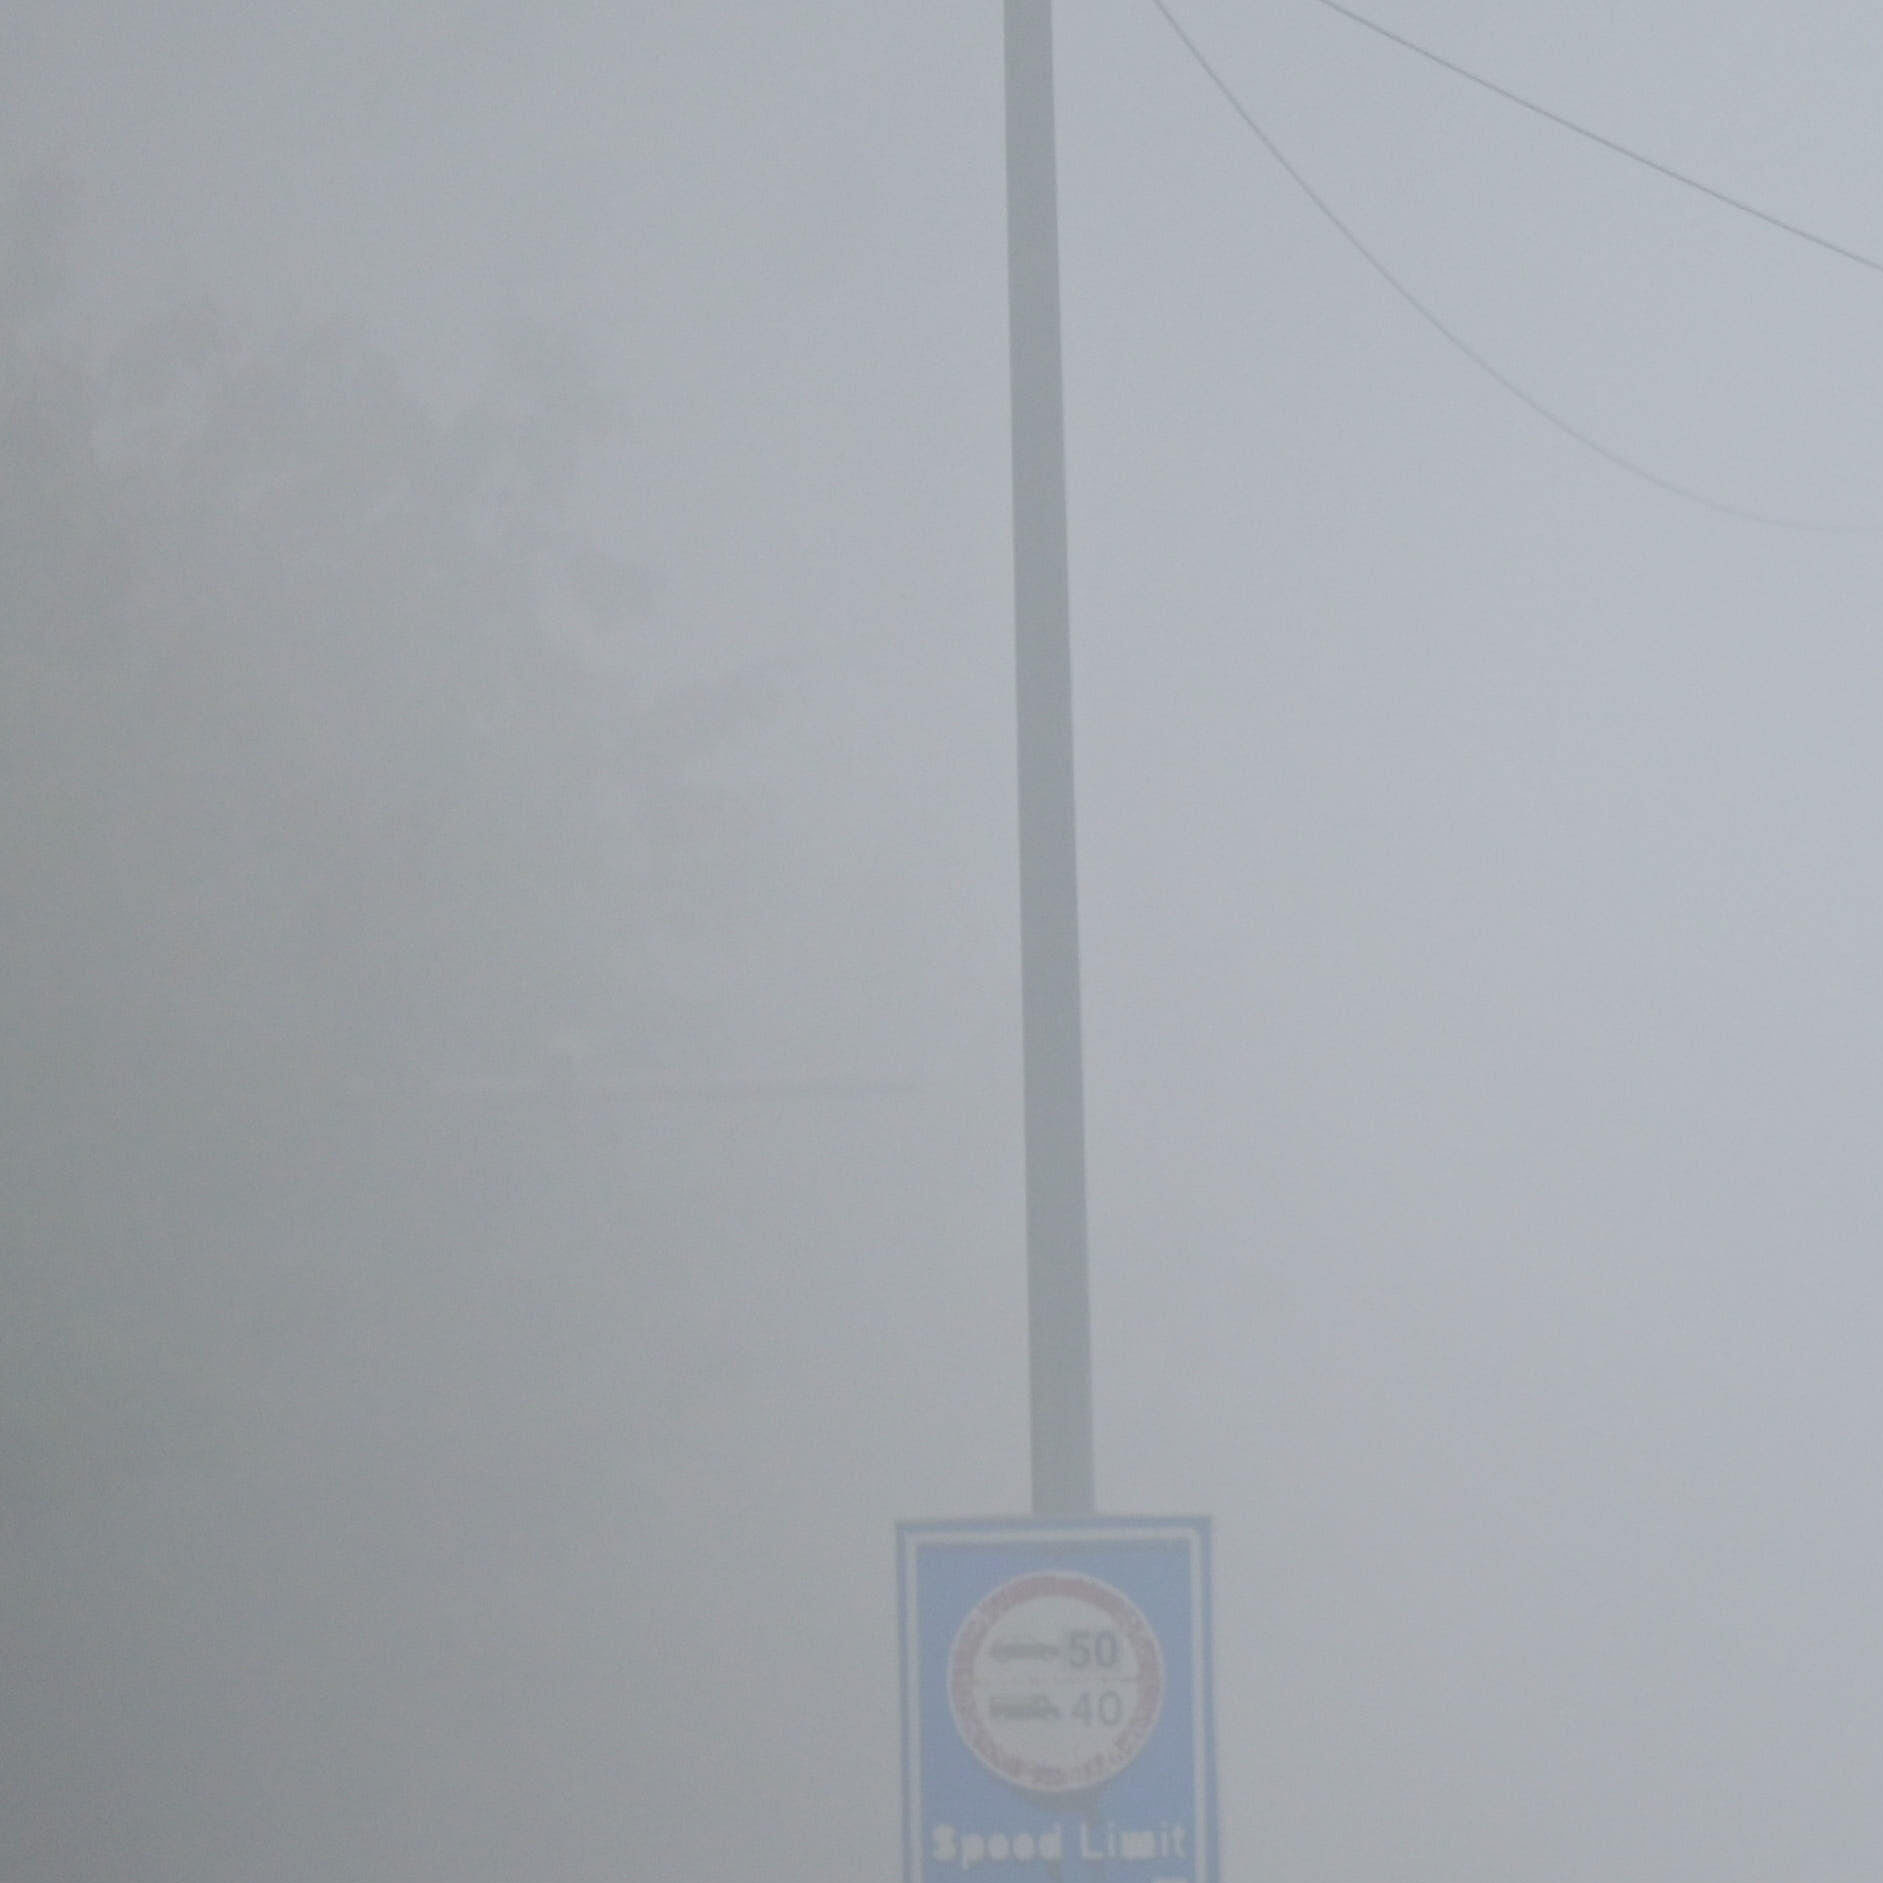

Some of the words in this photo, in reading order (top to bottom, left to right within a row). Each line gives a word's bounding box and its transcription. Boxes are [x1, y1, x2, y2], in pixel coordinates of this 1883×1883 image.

[1067, 1630, 1118, 1669] 50
[1071, 1690, 1123, 1728] 40
[932, 1822, 1063, 1870] Speed
[1081, 1822, 1187, 1860] Limit
